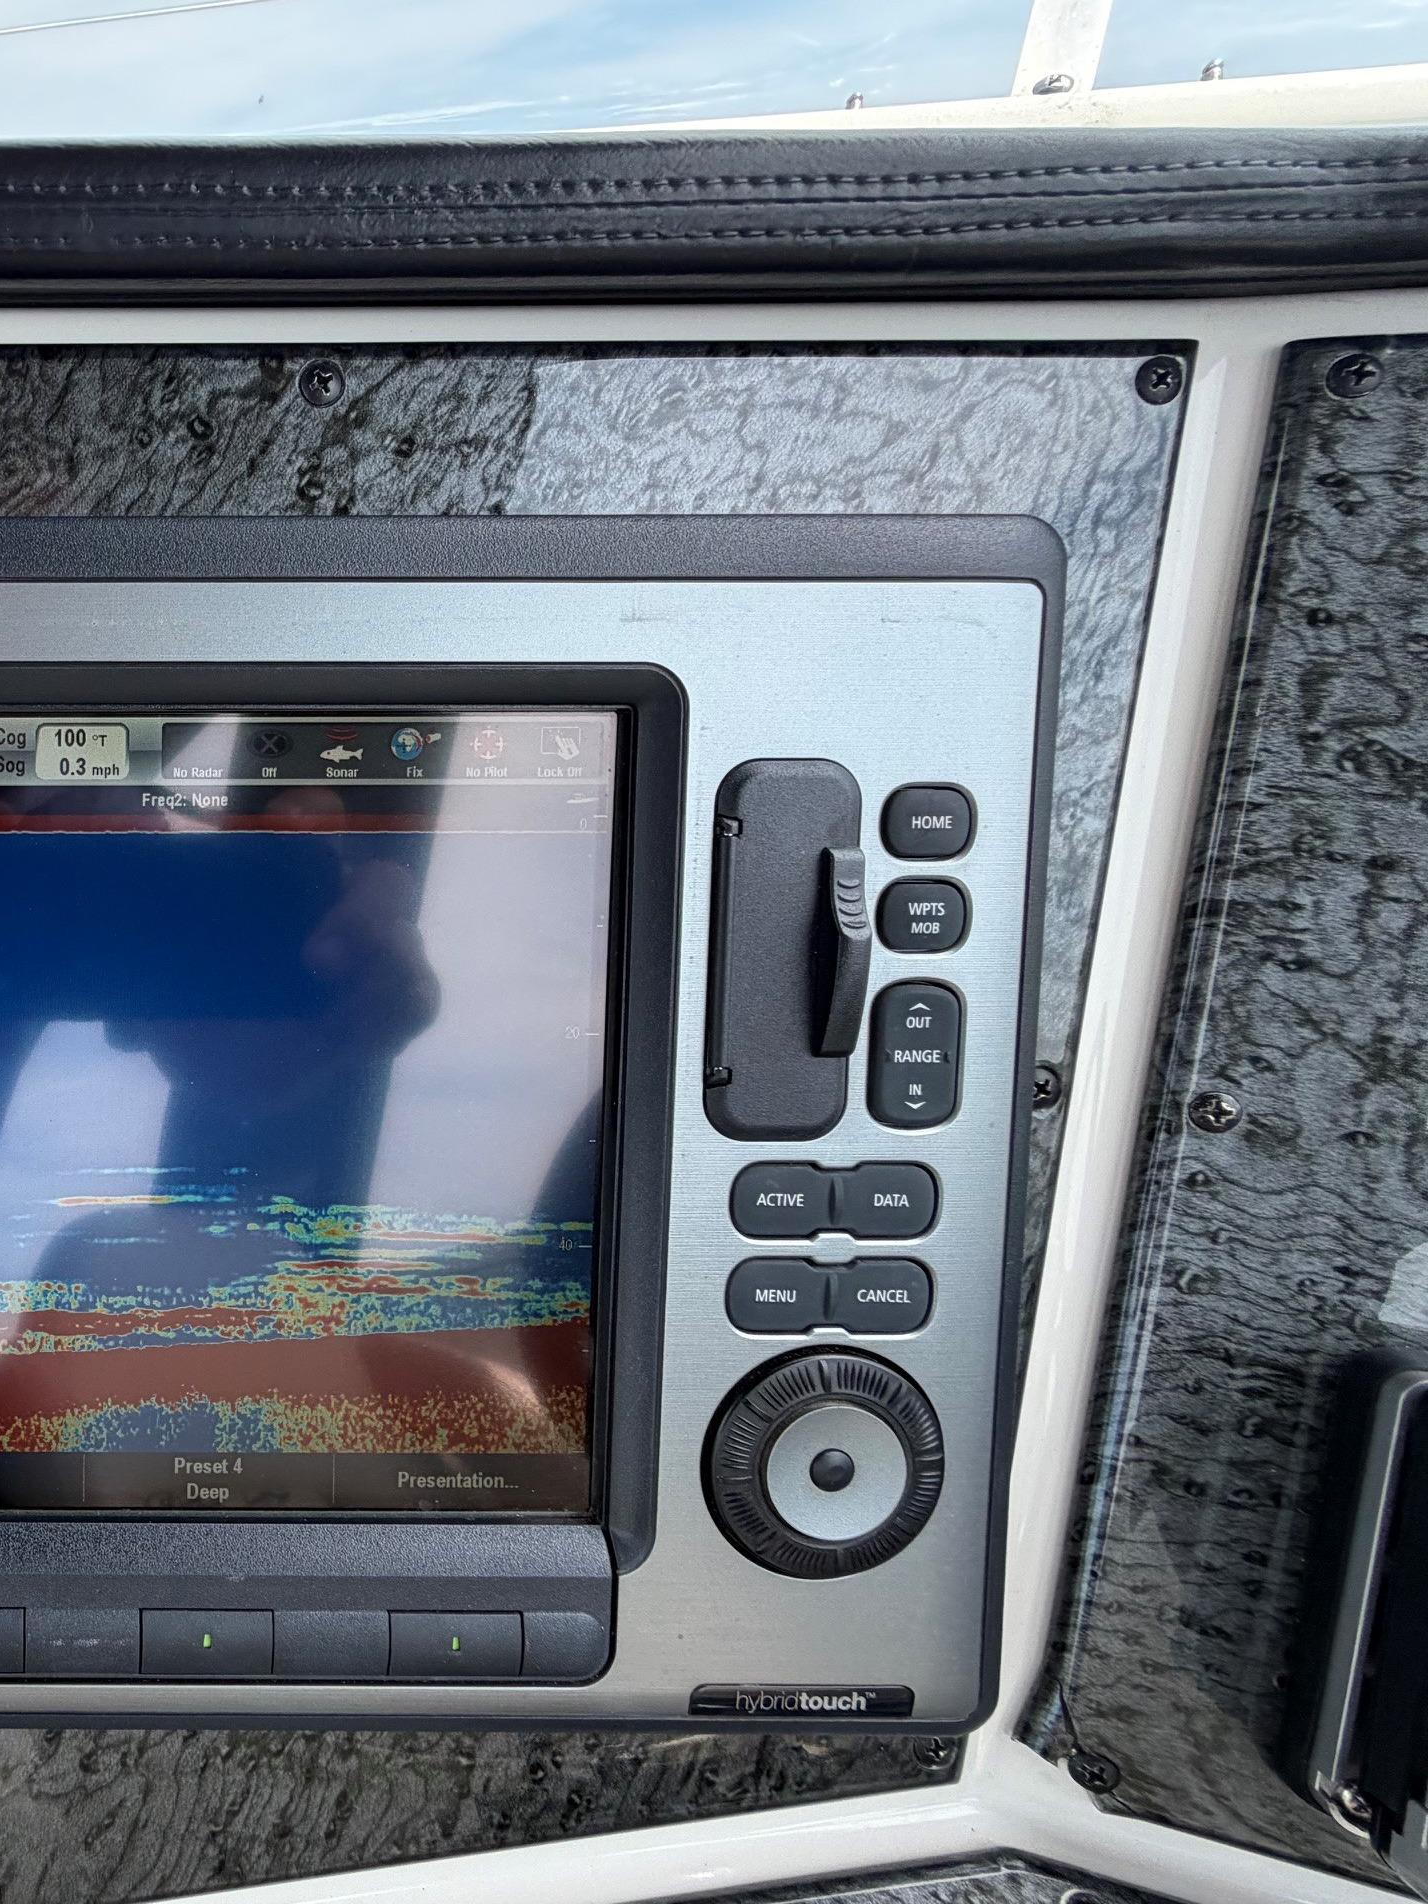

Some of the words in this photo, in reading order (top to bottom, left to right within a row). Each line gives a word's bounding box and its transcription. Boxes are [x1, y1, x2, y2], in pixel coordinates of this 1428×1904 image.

[53, 728, 86, 748] 100
[59, 757, 86, 776] 0.3
[92, 763, 120, 779] mph
[173, 767, 188, 778] No
[192, 767, 223, 778] Radar
[261, 767, 277, 778] Off
[326, 767, 359, 778] Sonar
[406, 767, 423, 778] Fix
[465, 767, 481, 778] No
[484, 766, 508, 778] Pilot
[537, 767, 564, 778] Lock
[567, 767, 583, 778] Off
[142, 793, 188, 810] Freq2:
[192, 793, 229, 808] None
[911, 815, 953, 829] HOME
[908, 902, 945, 916] WPTS
[910, 922, 940, 934] MOB
[905, 1016, 932, 1029] OUT
[894, 1050, 941, 1063] RANGE
[909, 1084, 922, 1096] IN
[756, 1193, 805, 1207] ACTIVE
[874, 1194, 909, 1208] DATA
[755, 1289, 796, 1303] MENU
[857, 1289, 912, 1304] CANCEL
[174, 1457, 230, 1475] Preset
[232, 1458, 243, 1474] 4
[186, 1483, 230, 1503] Deep
